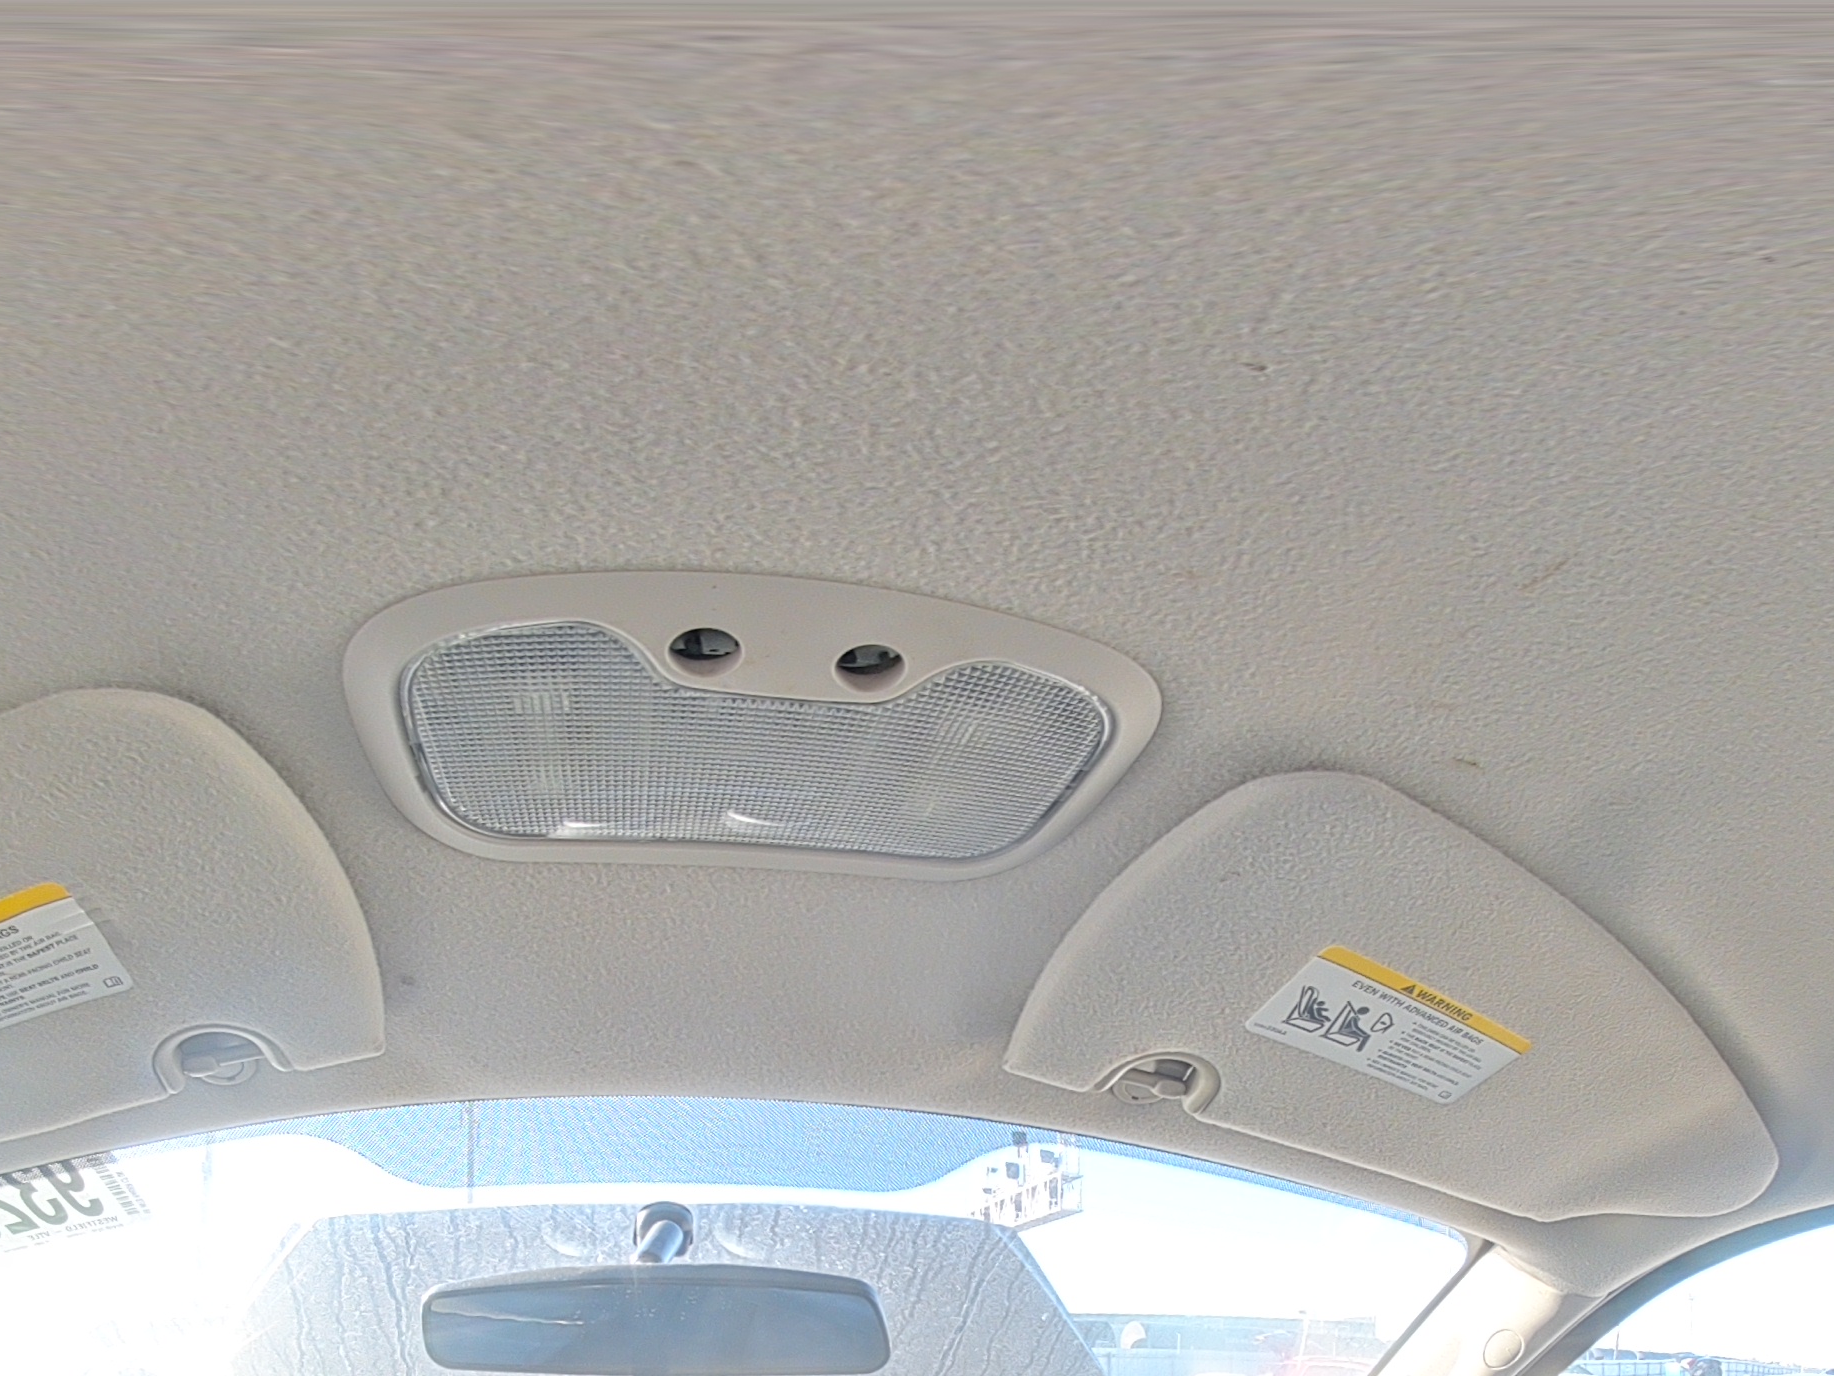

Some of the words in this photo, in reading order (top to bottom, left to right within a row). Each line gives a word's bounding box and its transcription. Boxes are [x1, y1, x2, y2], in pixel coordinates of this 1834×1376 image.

[1352, 980, 1379, 997] EVEN
[1379, 990, 1404, 1008] WITH
[1403, 1001, 1448, 1026] ADVANCED
[1445, 1021, 1463, 1036] AIR
[1461, 1028, 1485, 1046] BAGS
[1417, 988, 1473, 1022] WARNING
